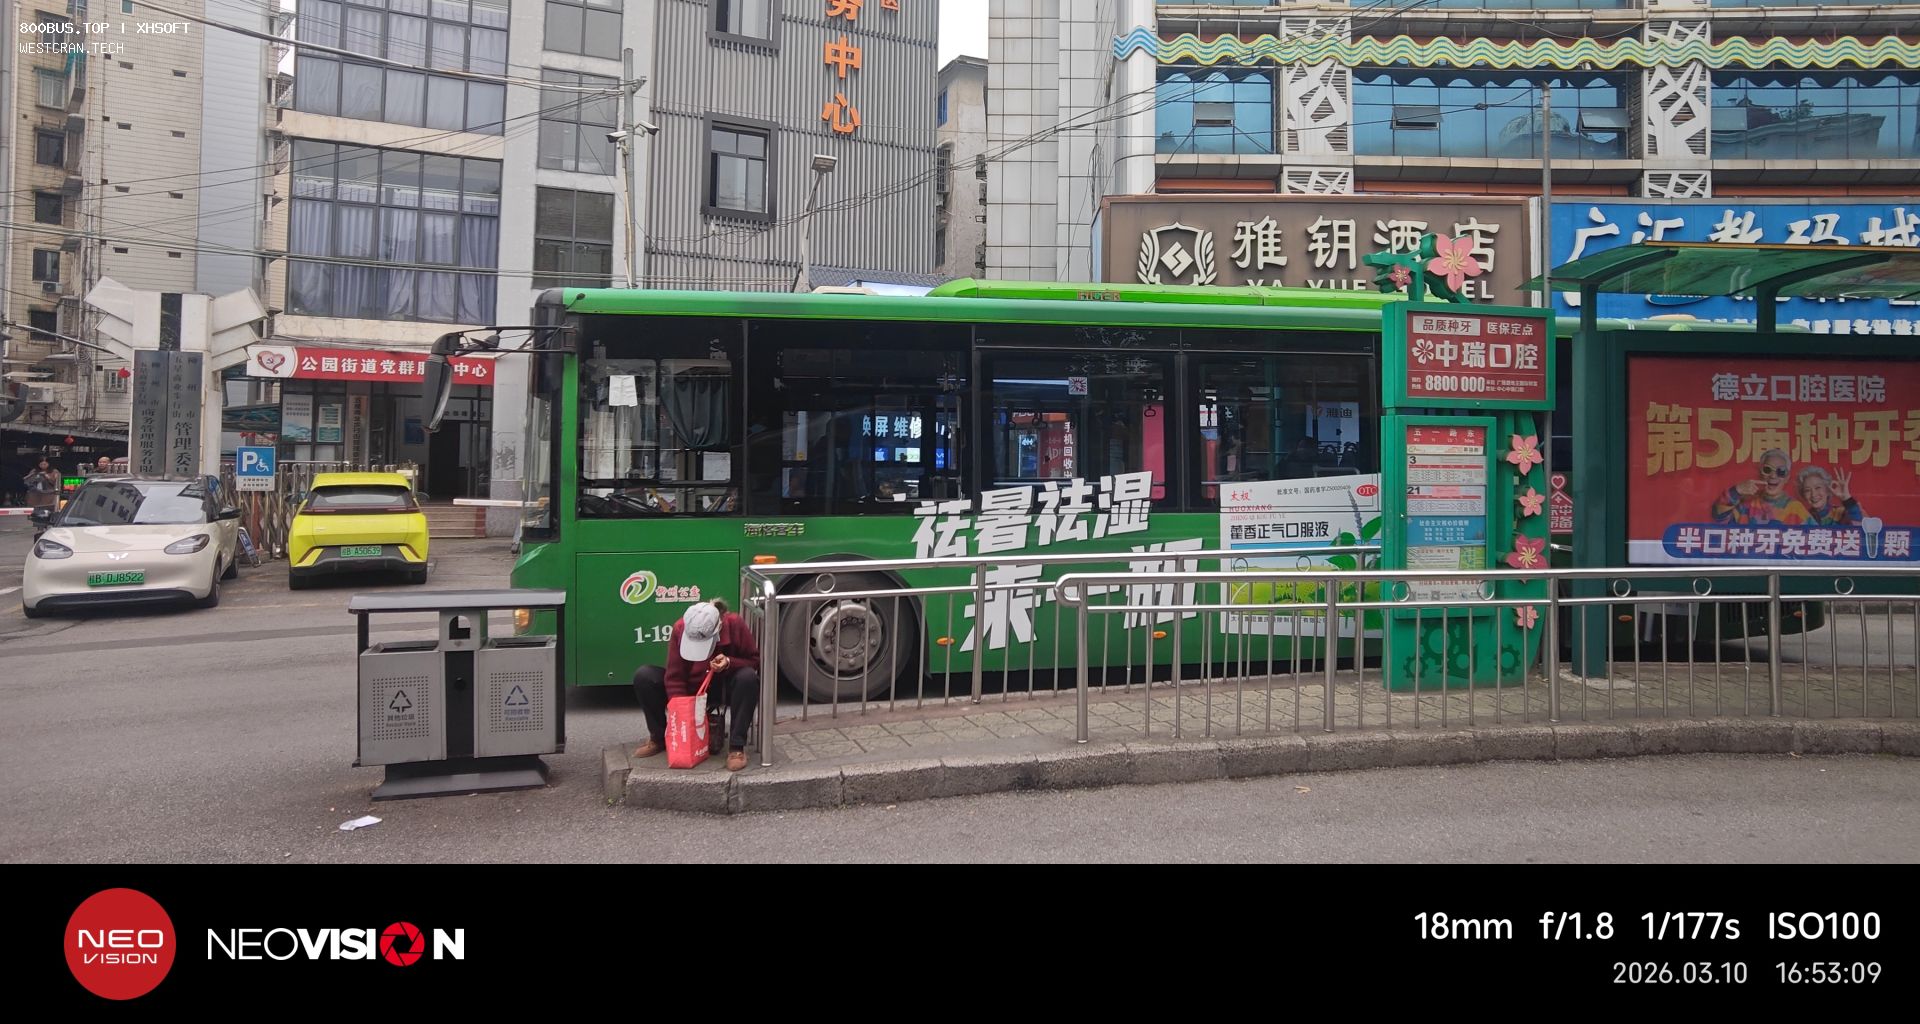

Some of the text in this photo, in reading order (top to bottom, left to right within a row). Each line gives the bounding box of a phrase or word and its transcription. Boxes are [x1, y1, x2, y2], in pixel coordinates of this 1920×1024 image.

[1230, 215, 1501, 273] 雅钥酒店
[1422, 319, 1534, 336] 品质种牙 医保定点
[1435, 340, 1538, 370] 中瑞口腔
[301, 355, 488, 378] 公园街道党群中心
[1425, 374, 1485, 393] 8800 000
[1711, 372, 1887, 403] 德立口腔医院
[242, 451, 258, 472] P
[1409, 455, 1417, 465] 3
[1359, 486, 1378, 497] OTC
[1407, 486, 1421, 495] 21
[911, 470, 1153, 560] 祛暑祛湿
[1230, 521, 1329, 540] 藿香正气口服液
[1676, 527, 1910, 557] 半口种牙免费送 颗
